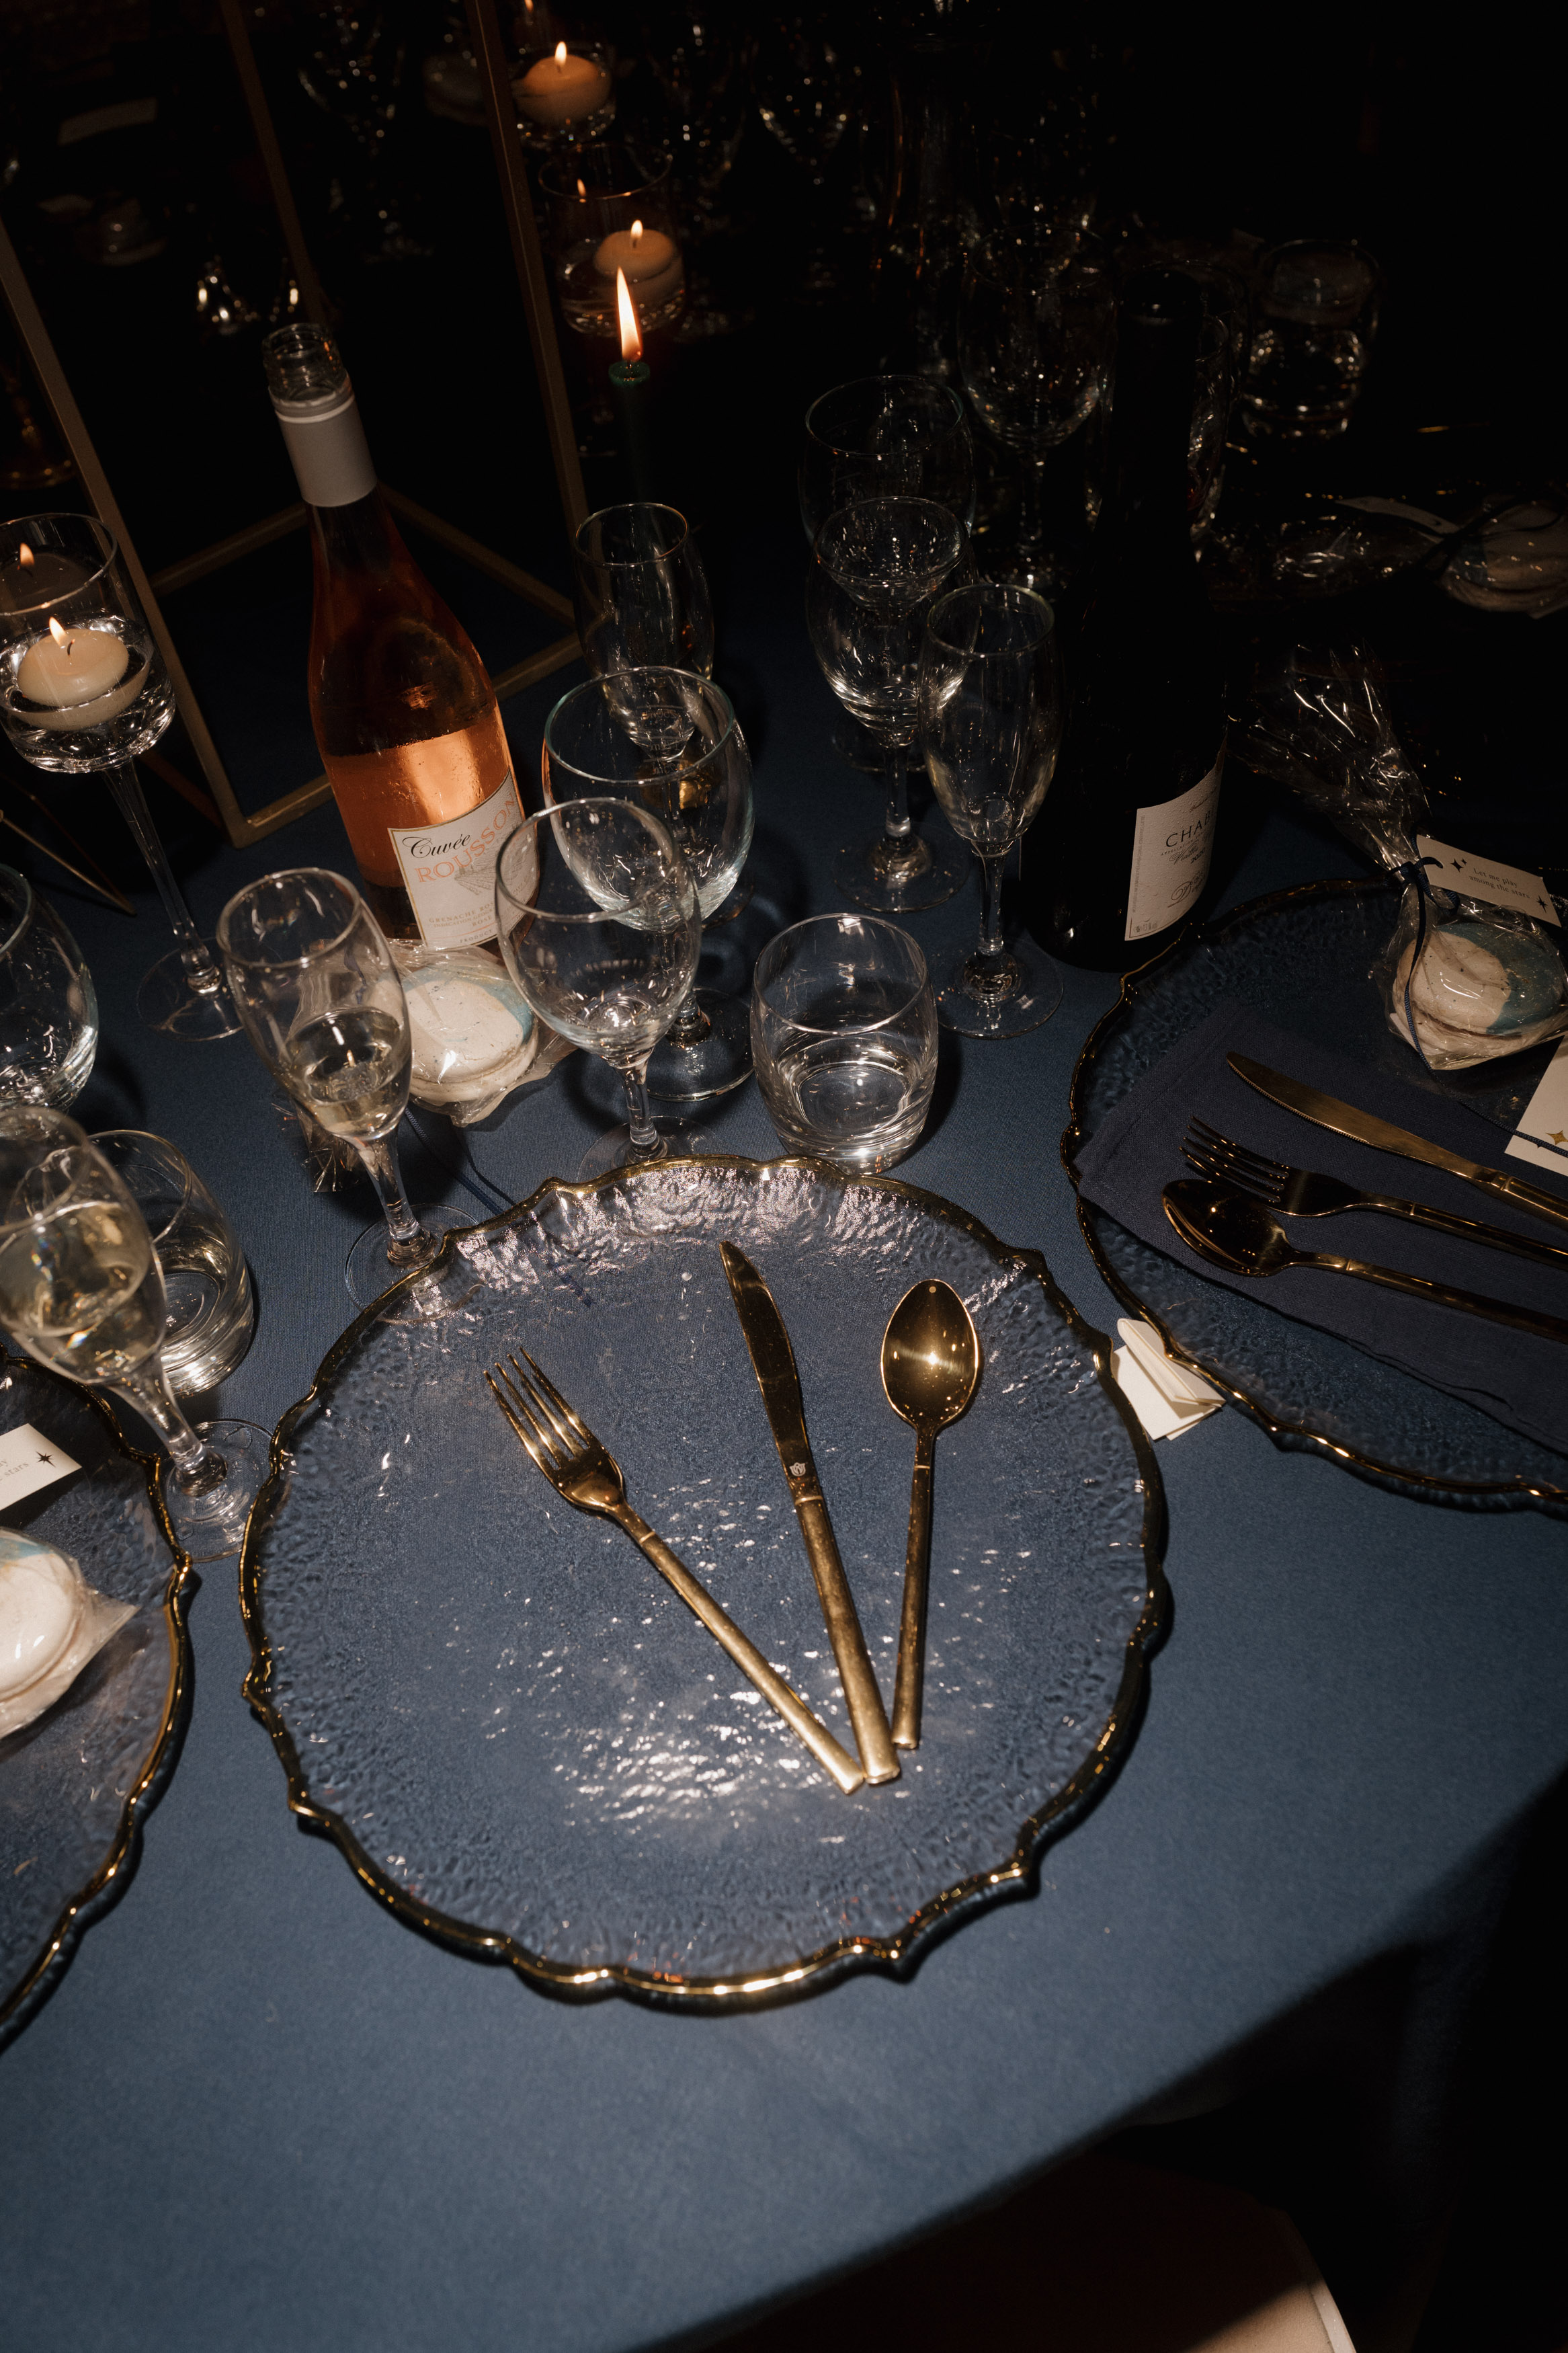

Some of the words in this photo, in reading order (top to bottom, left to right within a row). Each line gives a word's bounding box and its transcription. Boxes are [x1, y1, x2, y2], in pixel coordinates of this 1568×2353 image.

[402, 834, 470, 859] Cuvée
[414, 792, 515, 883] ROUSSON
[1469, 875, 1495, 889] among
[1496, 884, 1510, 893] the
[1511, 889, 1530, 900] stars
[1473, 867, 1487, 877] Let
[1489, 874, 1500, 882] me
[1502, 878, 1518, 889] play
[429, 910, 475, 923] GRENACHE
[460, 929, 493, 943] PRODUCT
[4, 1462, 29, 1477] stars
